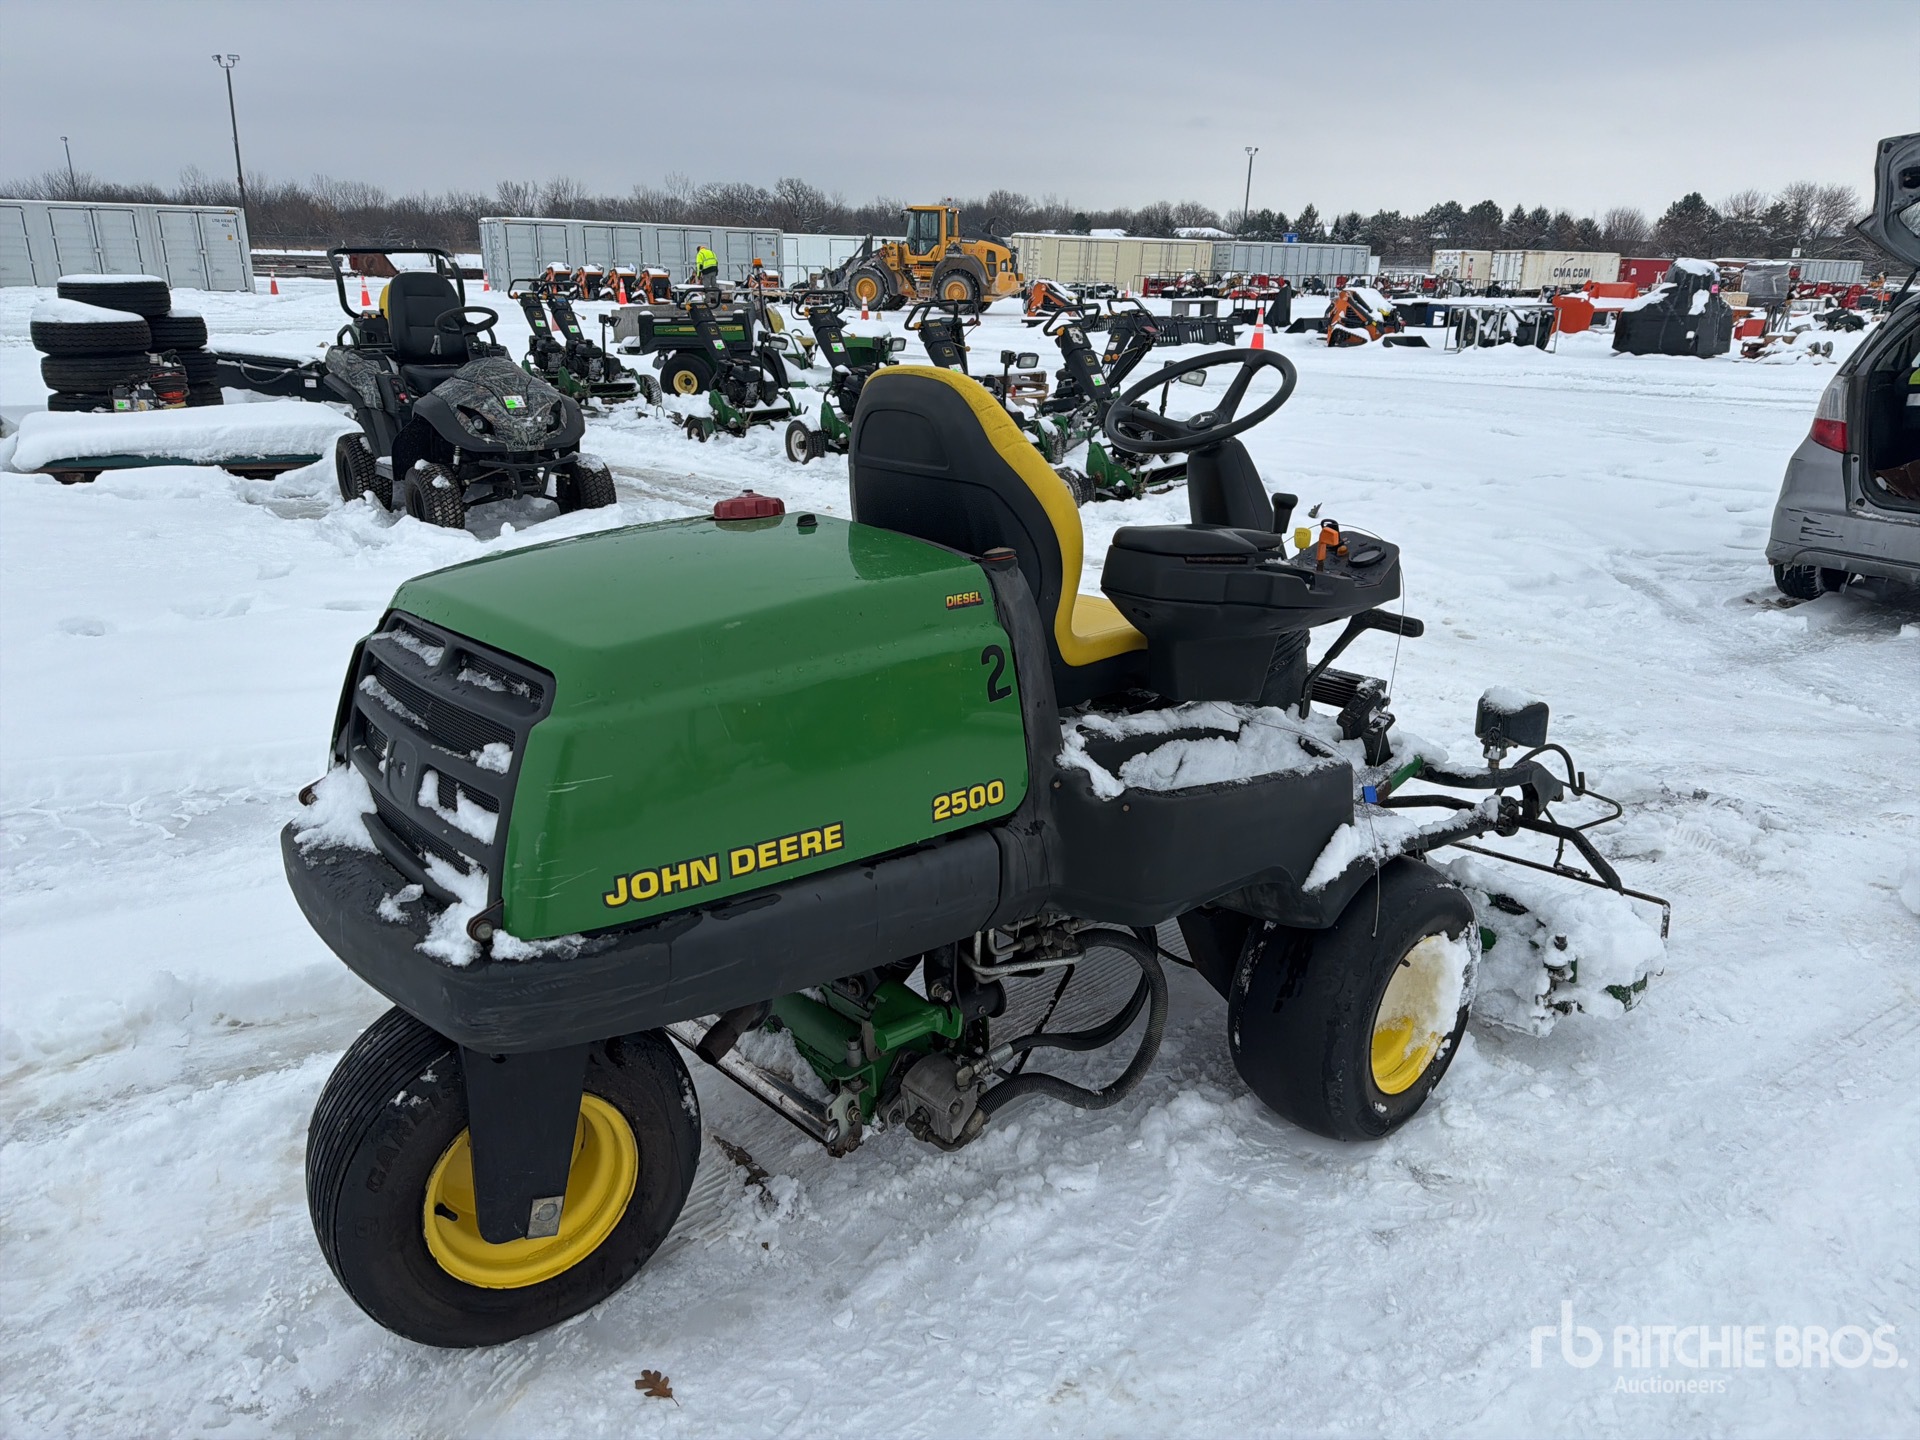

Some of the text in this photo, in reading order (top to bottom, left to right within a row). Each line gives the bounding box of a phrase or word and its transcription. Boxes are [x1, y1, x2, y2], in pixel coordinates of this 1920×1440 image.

[1553, 267, 1591, 278] CMA CGM
[945, 590, 983, 608] DIESEL
[981, 644, 1012, 703] 2
[932, 778, 1005, 822] 2500
[603, 821, 844, 907] JOHN DEERE
